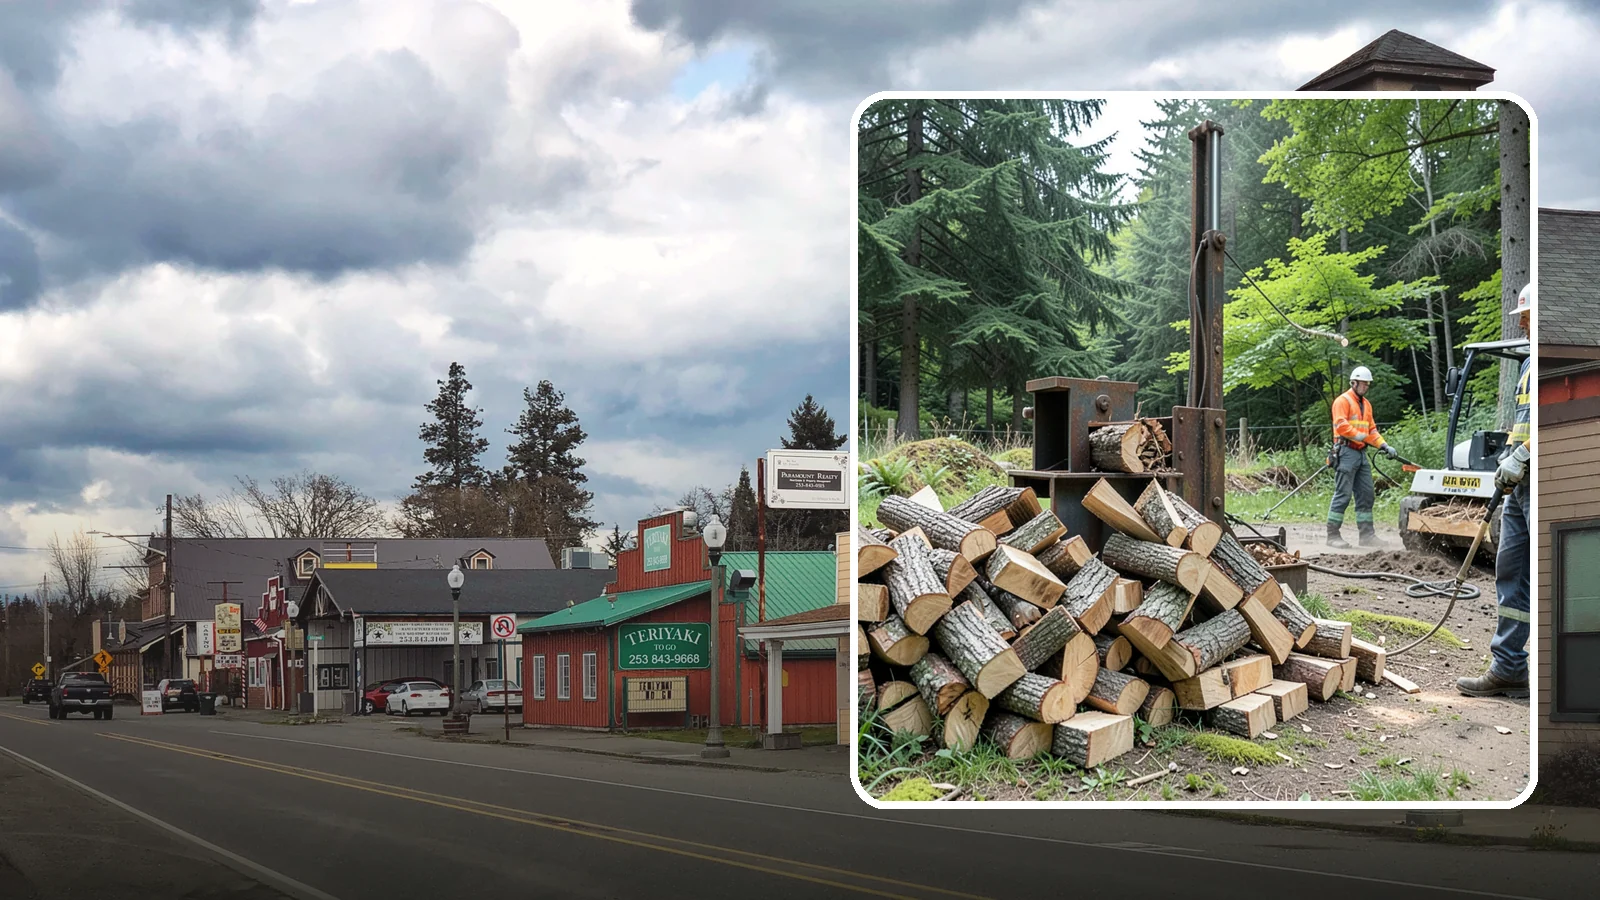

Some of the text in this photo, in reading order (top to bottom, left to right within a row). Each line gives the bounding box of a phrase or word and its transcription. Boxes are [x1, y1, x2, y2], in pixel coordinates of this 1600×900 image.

[624, 627, 702, 646] TERIYAKI
[628, 654, 700, 664] 253 843-9668
